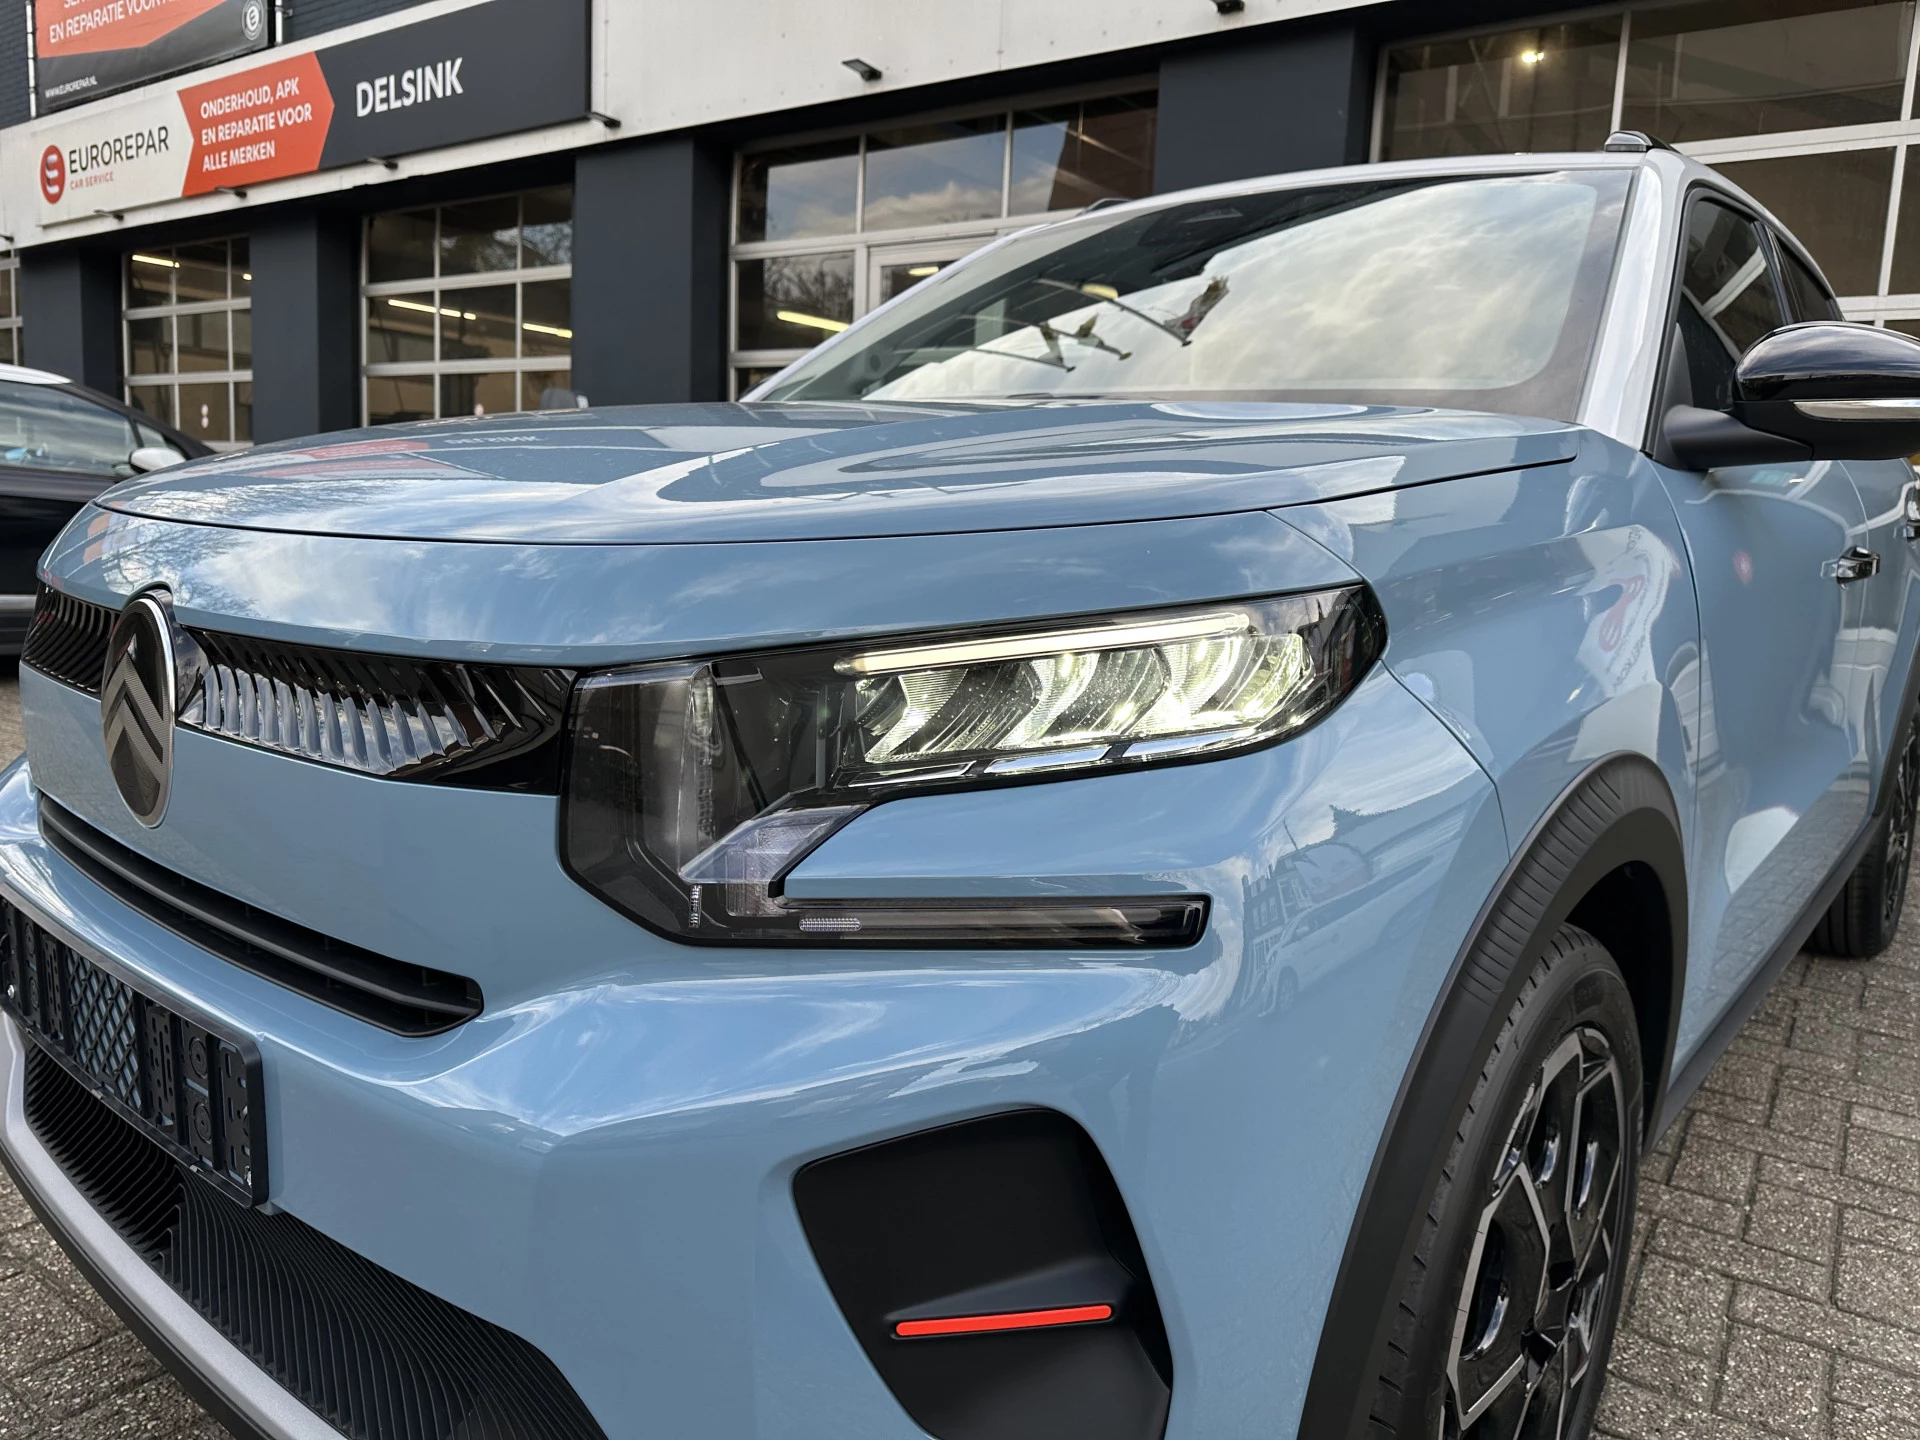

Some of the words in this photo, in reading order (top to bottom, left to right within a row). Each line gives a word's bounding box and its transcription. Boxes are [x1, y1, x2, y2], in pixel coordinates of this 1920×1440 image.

[49, 25, 64, 43] EN
[66, 1, 125, 38] REPARATIE
[200, 85, 273, 119] ONDERHOUD,
[275, 77, 300, 100] APK
[356, 57, 464, 117] DELSINK
[201, 127, 216, 146] EN
[217, 112, 276, 142] REPARATIE
[276, 102, 312, 127] VOOR
[69, 125, 169, 174] EUROREPAR
[203, 151, 228, 172] ALLE
[229, 140, 275, 166] MERKEN
[70, 178, 84, 190] CAR
[84, 171, 114, 187] SERVICE
